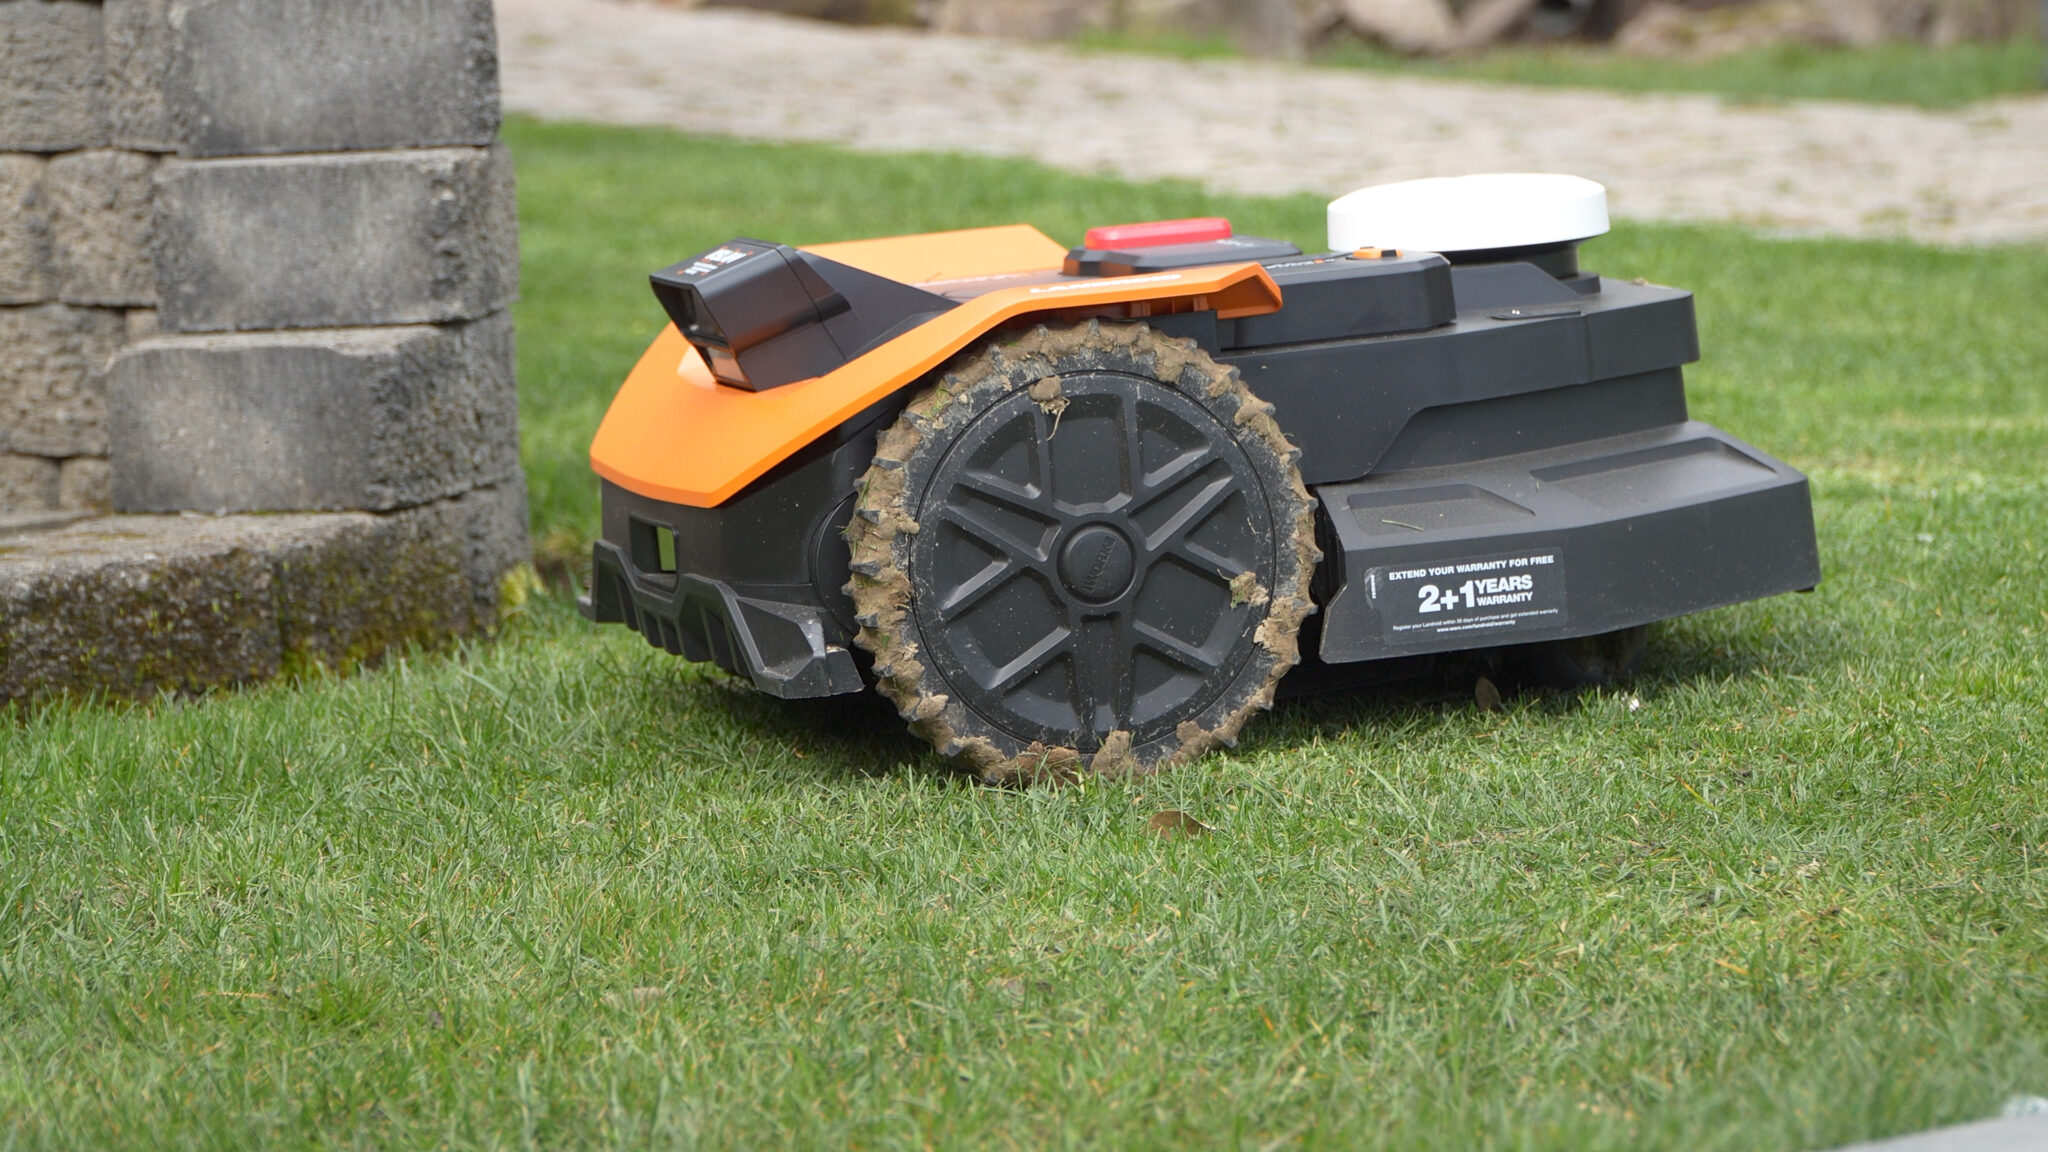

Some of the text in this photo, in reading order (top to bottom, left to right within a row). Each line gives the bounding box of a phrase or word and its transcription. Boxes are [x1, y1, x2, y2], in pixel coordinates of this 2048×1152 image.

[1388, 555, 1554, 580] EXTEND YOUR WARRANTY FOR FREE
[1418, 574, 1533, 613] 2+1 YEARS
[1476, 591, 1533, 607] WARRANTY
